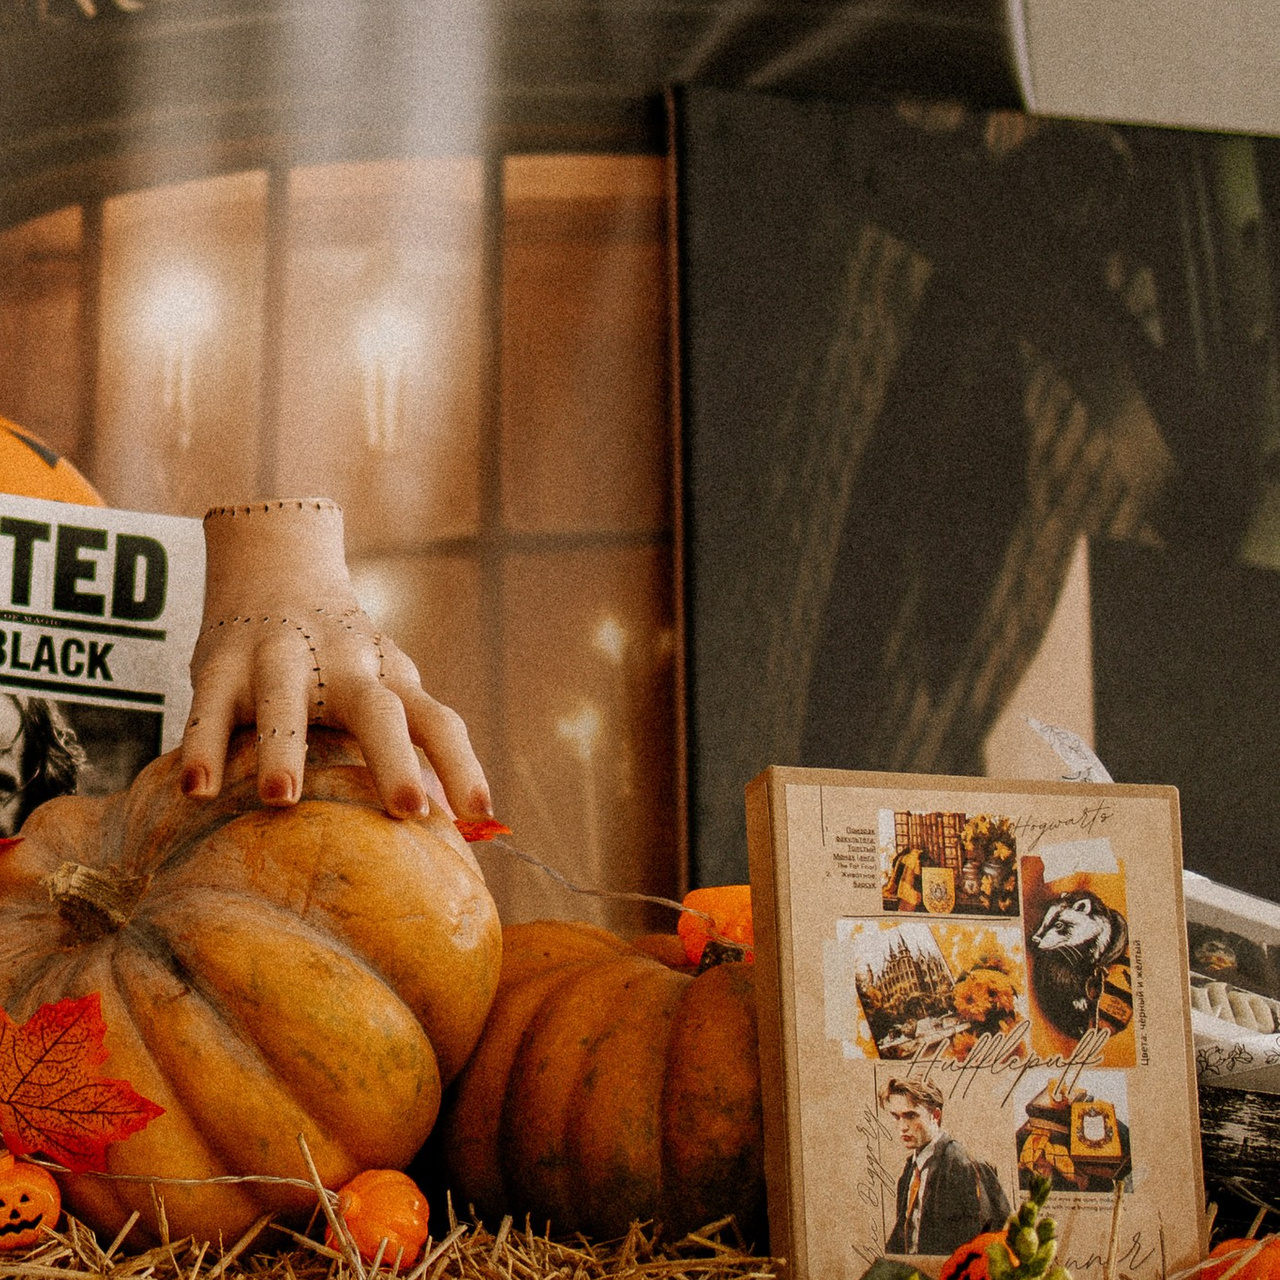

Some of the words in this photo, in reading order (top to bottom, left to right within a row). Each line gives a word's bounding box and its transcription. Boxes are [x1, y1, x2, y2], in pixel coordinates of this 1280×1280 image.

[3, 612, 19, 621] OF
[1010, 799, 1114, 852] Hogwarts
[906, 1020, 1109, 1109] Hufflepuff
